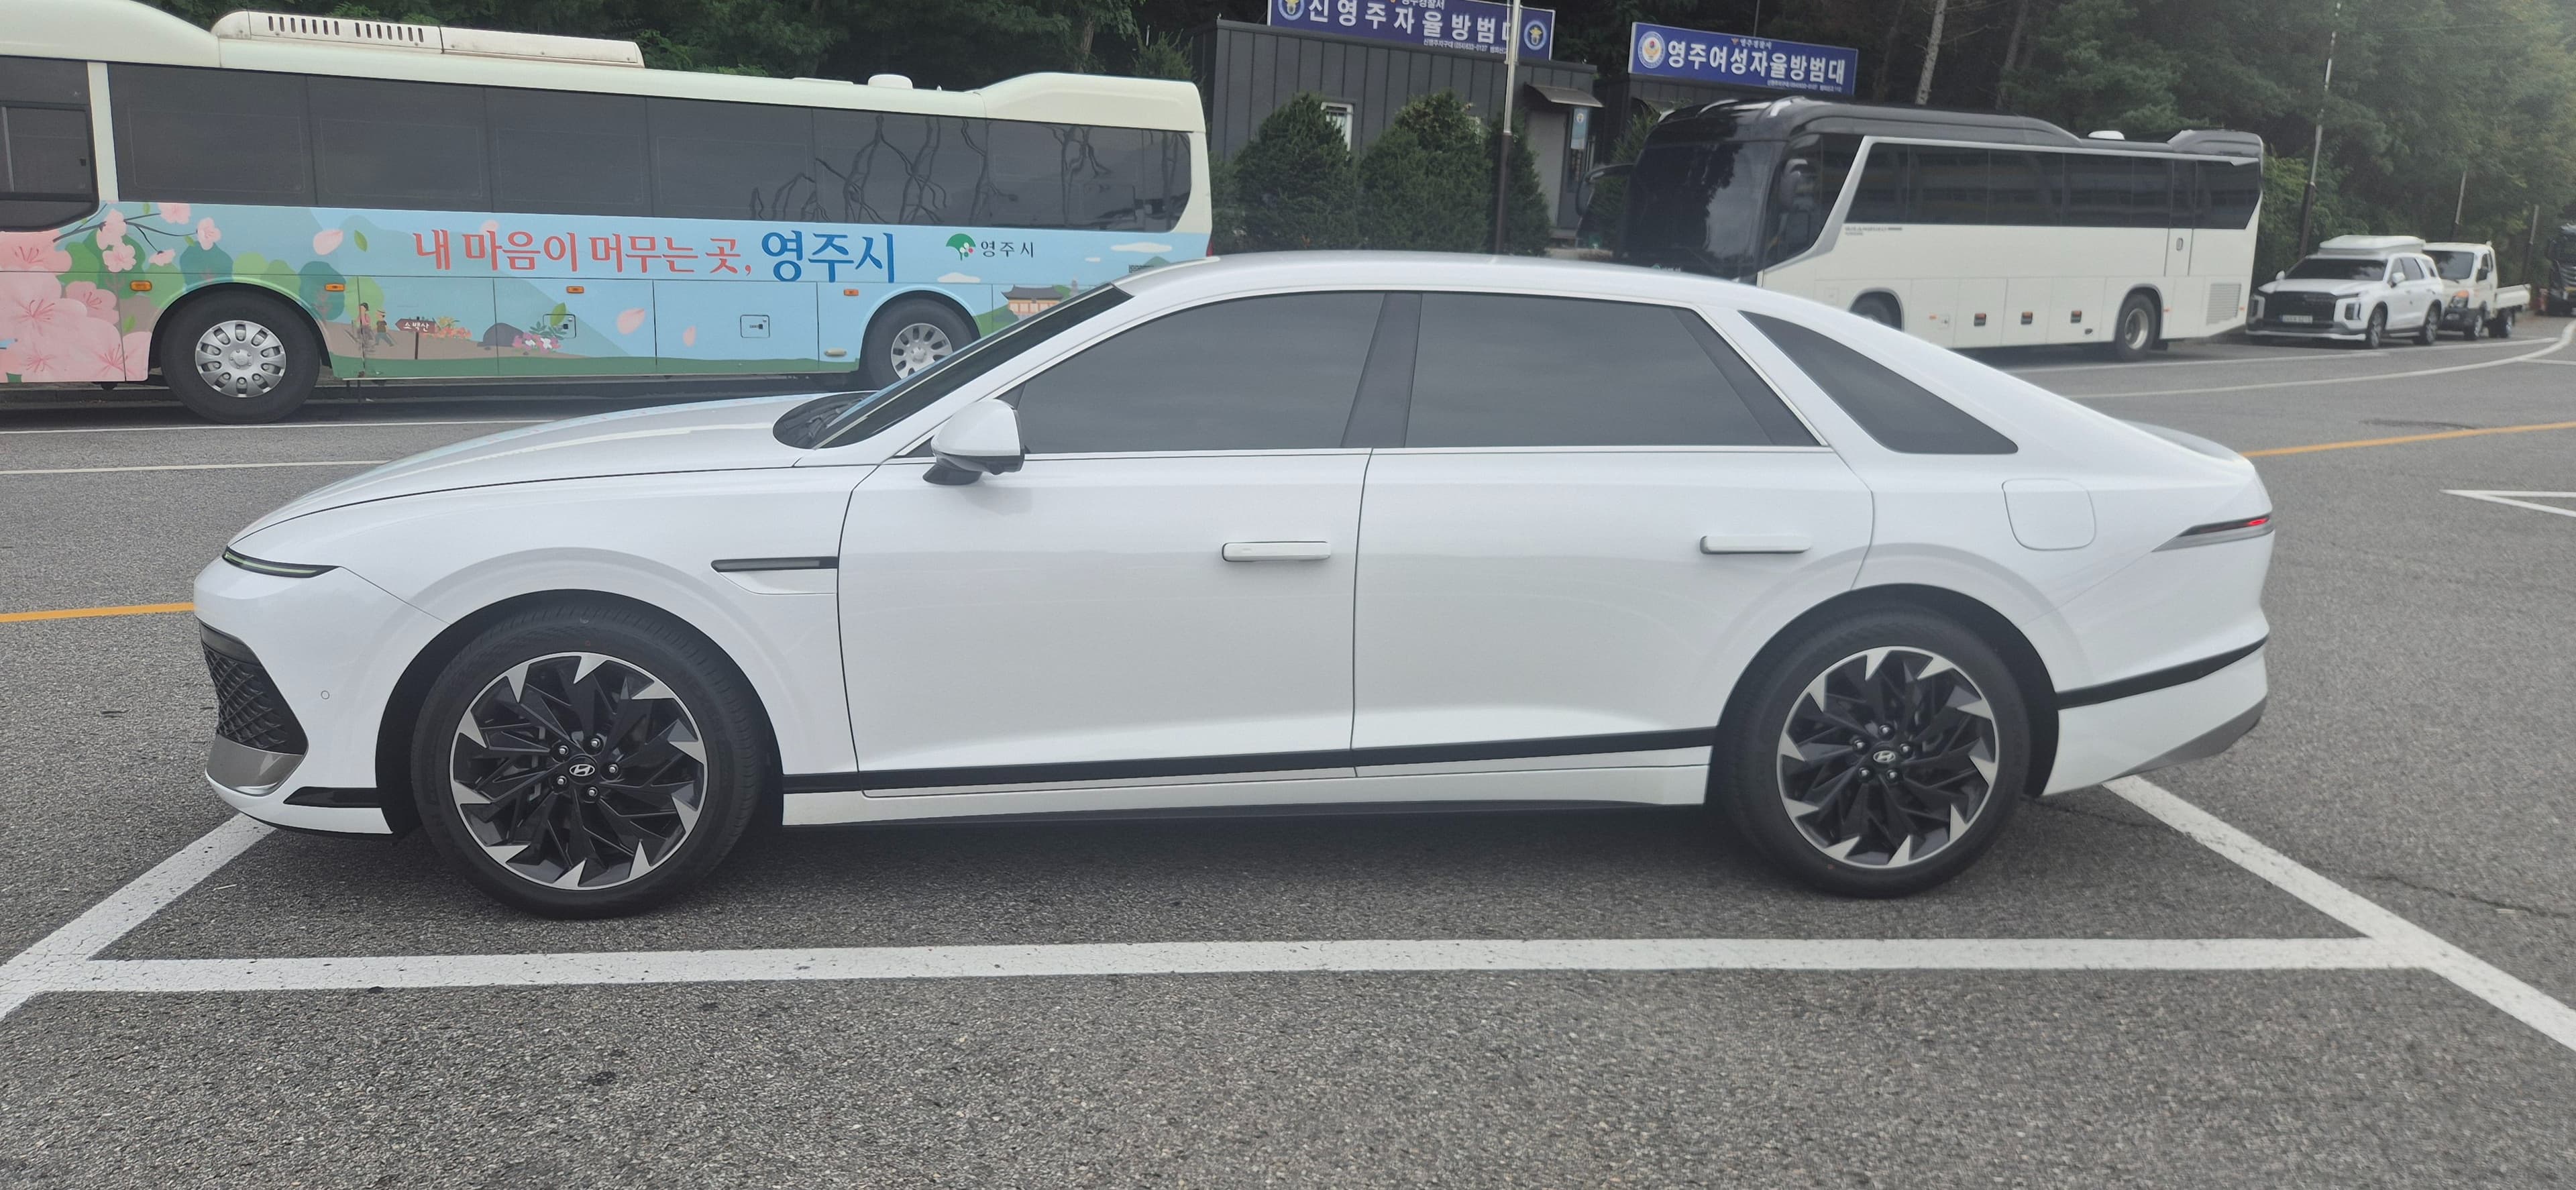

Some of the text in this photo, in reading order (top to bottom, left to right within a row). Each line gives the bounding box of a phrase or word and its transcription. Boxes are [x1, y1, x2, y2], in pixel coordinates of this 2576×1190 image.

[1667, 40, 1845, 86] 영주여성자율방범대
[413, 229, 895, 283] 내 마음이 머무는 곳, 영주시
[981, 241, 1034, 258] 영주시
[403, 322, 429, 332] 소백산
